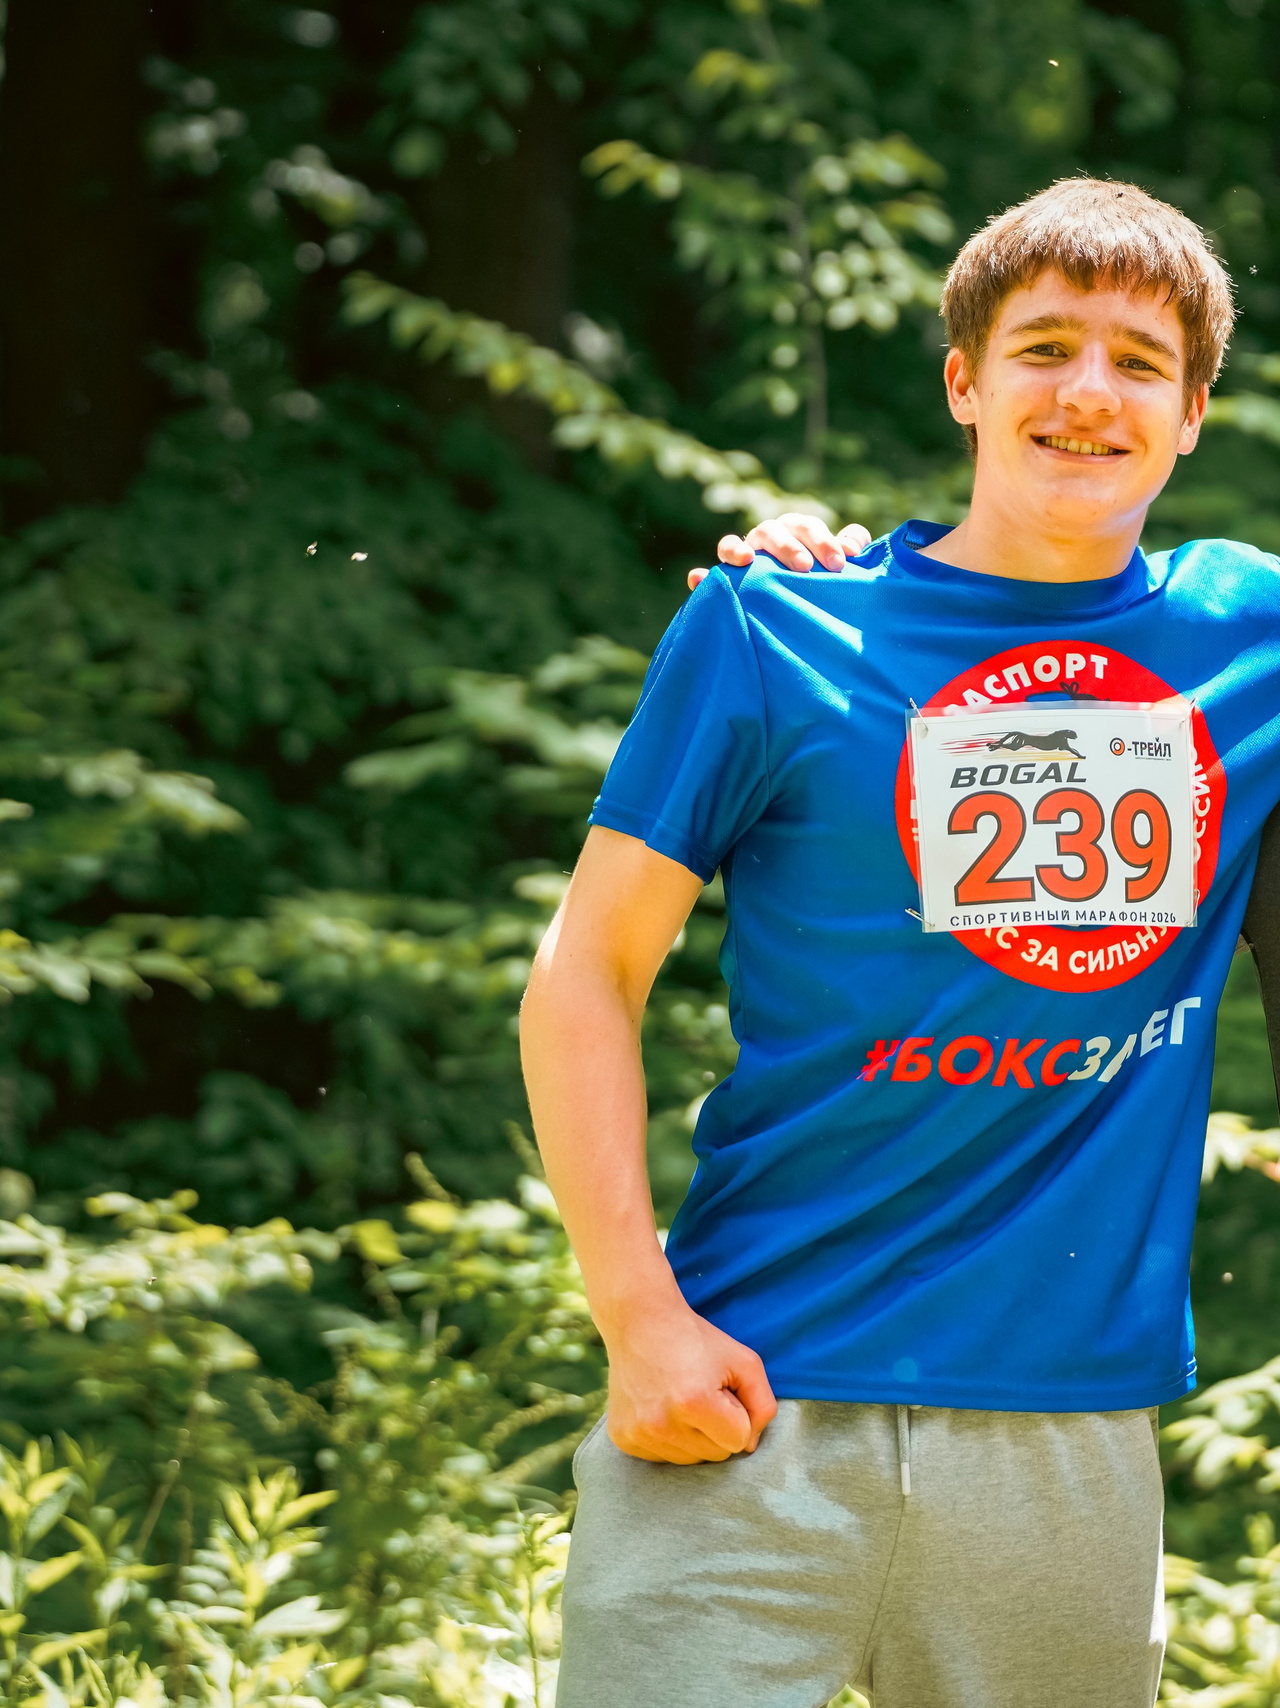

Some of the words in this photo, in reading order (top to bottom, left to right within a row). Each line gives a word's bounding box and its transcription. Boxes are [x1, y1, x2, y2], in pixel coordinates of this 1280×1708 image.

[945, 653, 1108, 712] АСПОРТ
[950, 762, 1088, 789] BOGAL
[947, 787, 1172, 907] 239
[950, 909, 1071, 927] СПОРТИВНЫЙ
[1075, 909, 1147, 923] МАРАФОН
[1151, 911, 1177, 923] 2026
[1020, 938, 1059, 972] ЗА
